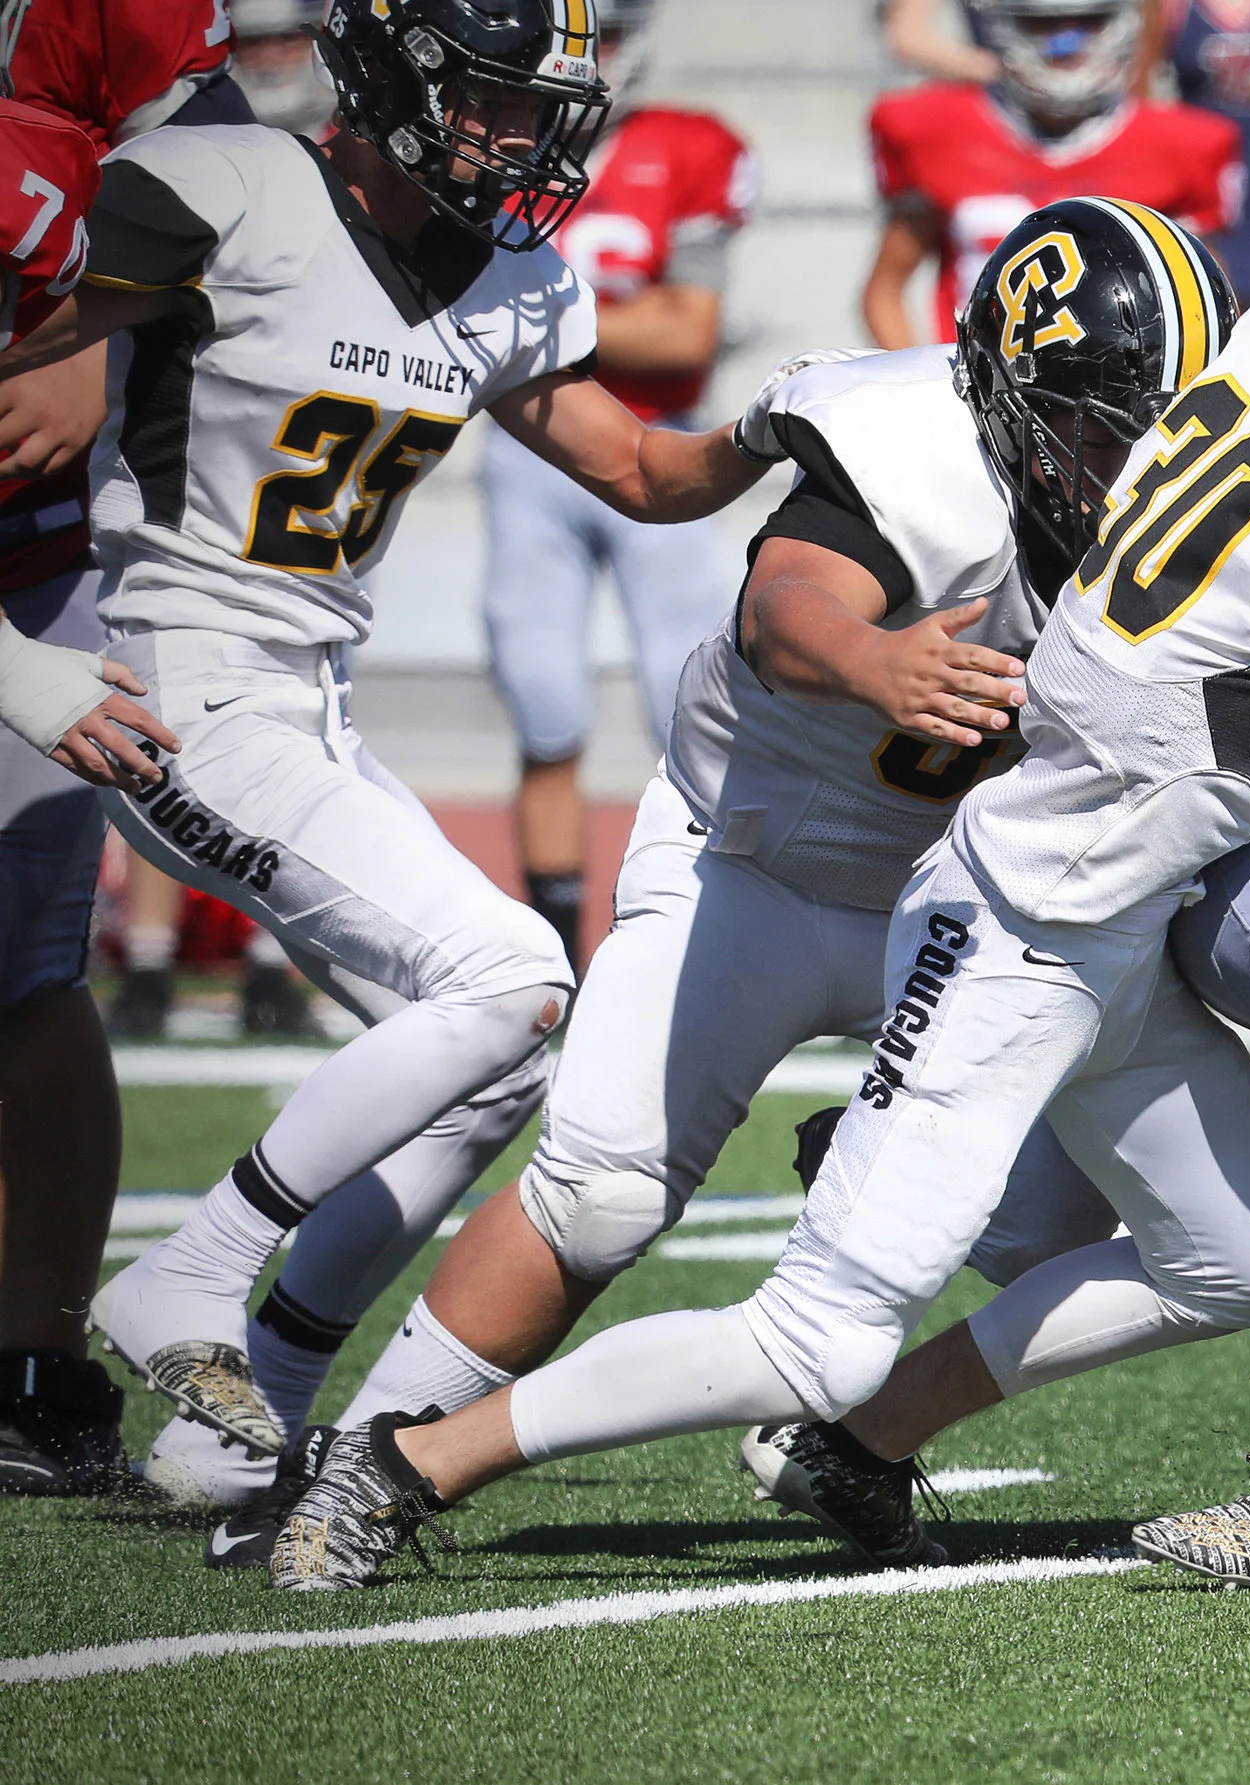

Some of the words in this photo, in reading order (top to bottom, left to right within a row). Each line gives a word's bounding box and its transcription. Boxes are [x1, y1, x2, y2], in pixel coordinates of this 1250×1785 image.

[330, 7, 348, 38] 25
[330, 340, 390, 378] CAPO
[402, 354, 475, 396] VALLEY
[240, 389, 467, 575] 25
[859, 912, 970, 1110] COUGARS
[304, 1429, 323, 1478] ALPH
